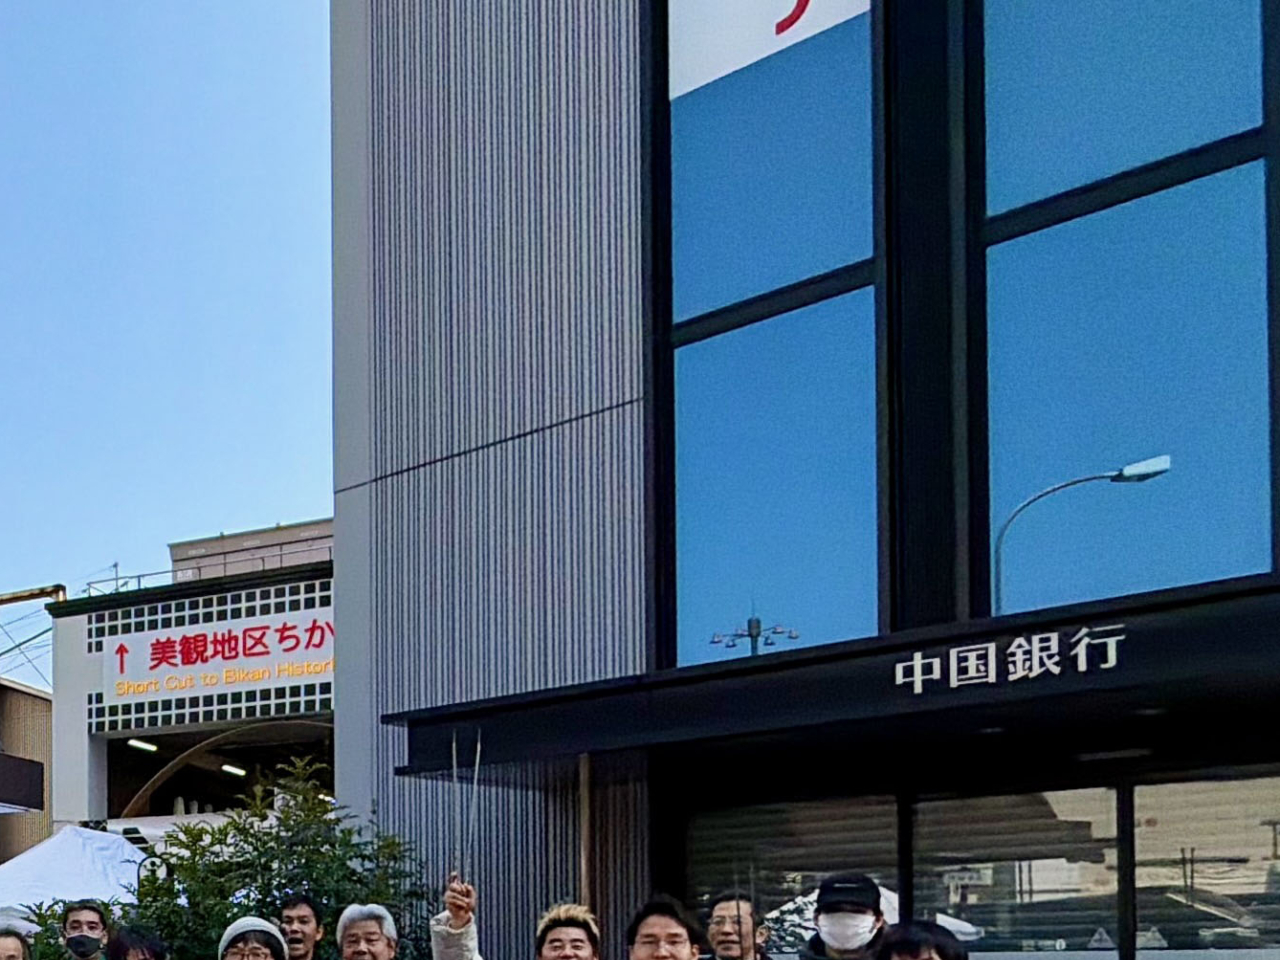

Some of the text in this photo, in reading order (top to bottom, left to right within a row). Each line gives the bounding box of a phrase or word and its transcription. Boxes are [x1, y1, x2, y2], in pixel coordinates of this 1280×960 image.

[149, 618, 335, 670] 美観地区ちか
[895, 624, 1126, 694] 中国銀行
[115, 676, 160, 696] Short
[164, 674, 196, 691] Cut
[201, 671, 218, 686] to
[223, 663, 270, 685] Bikan
